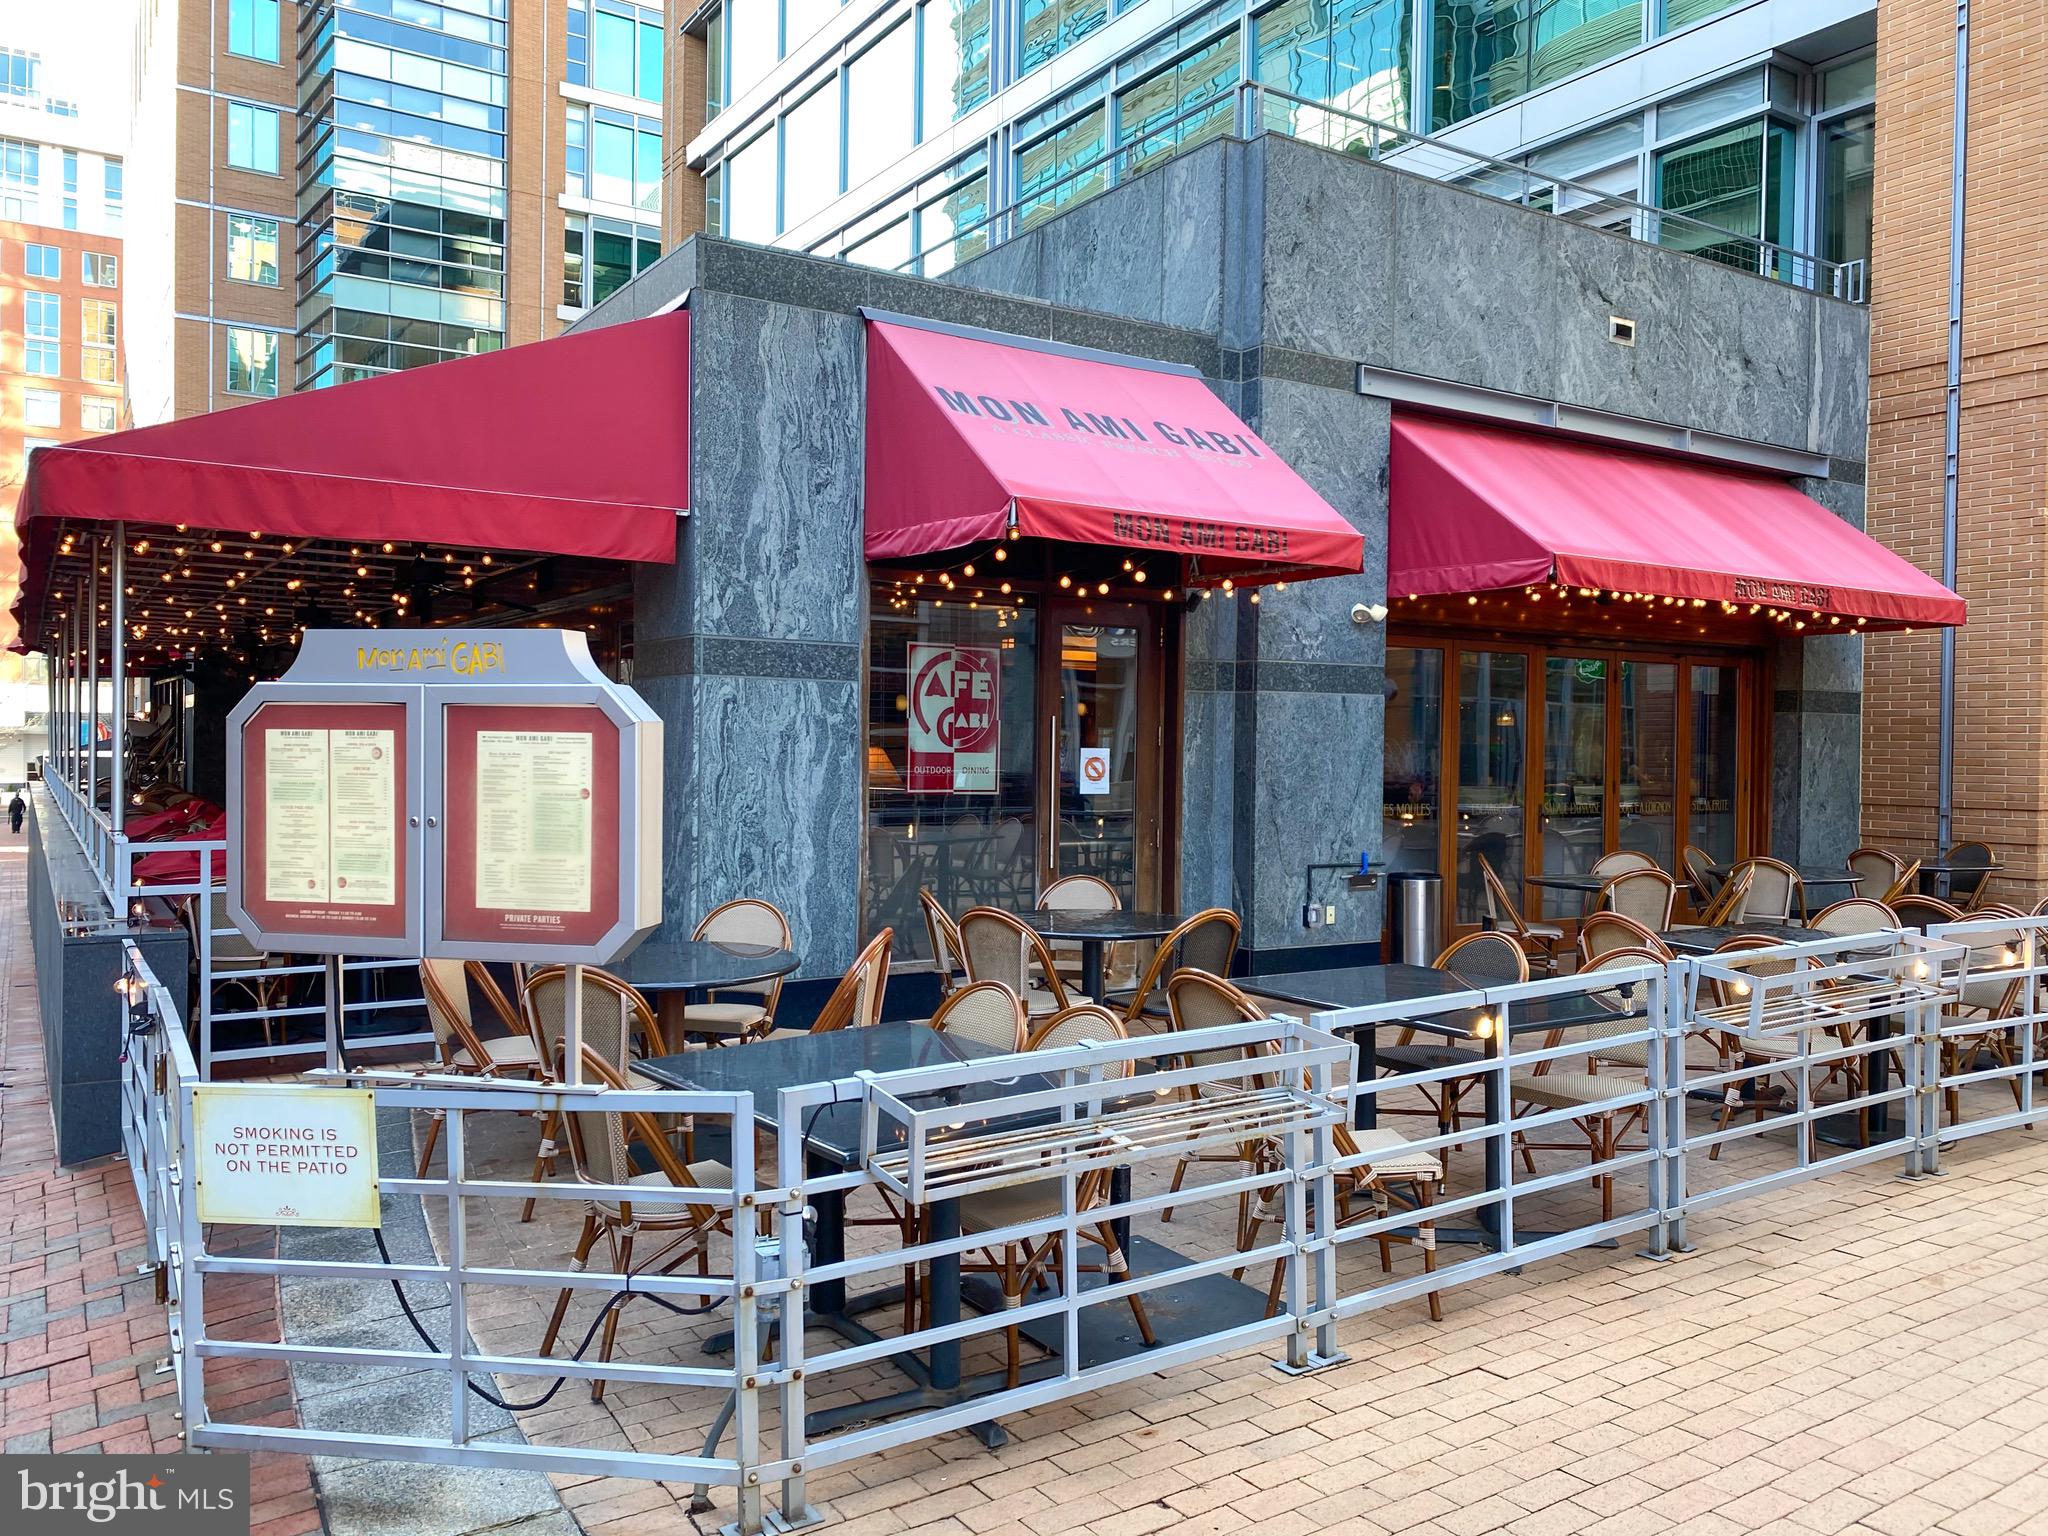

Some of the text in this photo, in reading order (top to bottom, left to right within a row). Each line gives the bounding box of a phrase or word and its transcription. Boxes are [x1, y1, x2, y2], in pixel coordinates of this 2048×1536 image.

[934, 386, 1263, 457] MON AMI GABI
[1113, 512, 1288, 556] MON AMI GABI
[357, 637, 505, 676] Mon Ami GABI
[936, 706, 990, 748] GABI
[914, 764, 990, 775] OUTDOOR DINING
[1383, 803, 1431, 817] ES MOULES
[504, 914, 561, 924] PRIVATE PARTIES
[233, 1126, 337, 1141] SMOKING IS
[215, 1143, 358, 1158] NOT PERMITTED
[226, 1159, 348, 1175] ON THE PATIO
